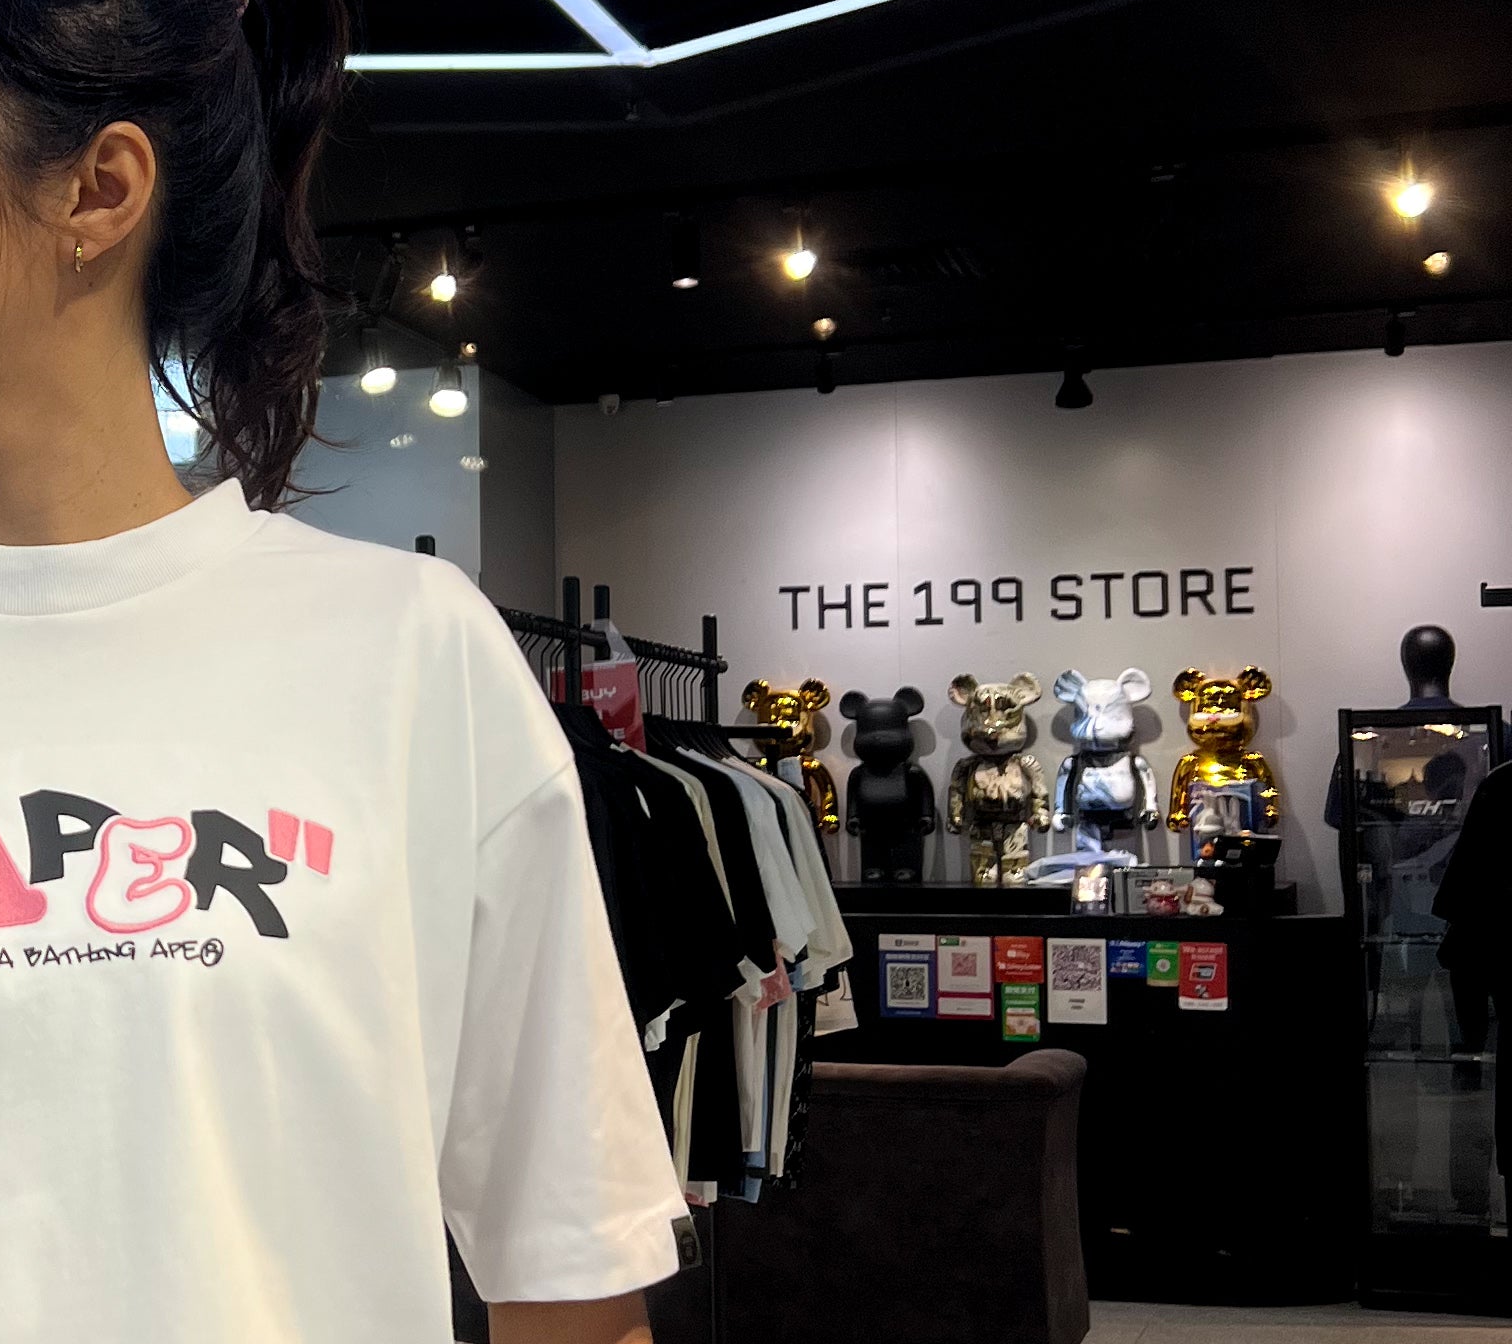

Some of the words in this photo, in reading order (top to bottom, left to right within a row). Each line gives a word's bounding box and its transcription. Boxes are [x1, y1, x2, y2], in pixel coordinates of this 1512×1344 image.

[779, 582, 890, 630] THE
[913, 576, 1024, 626] 199
[1050, 566, 1255, 621] STORE
[582, 686, 616, 701] BUY
[23, 941, 136, 967] BATHING
